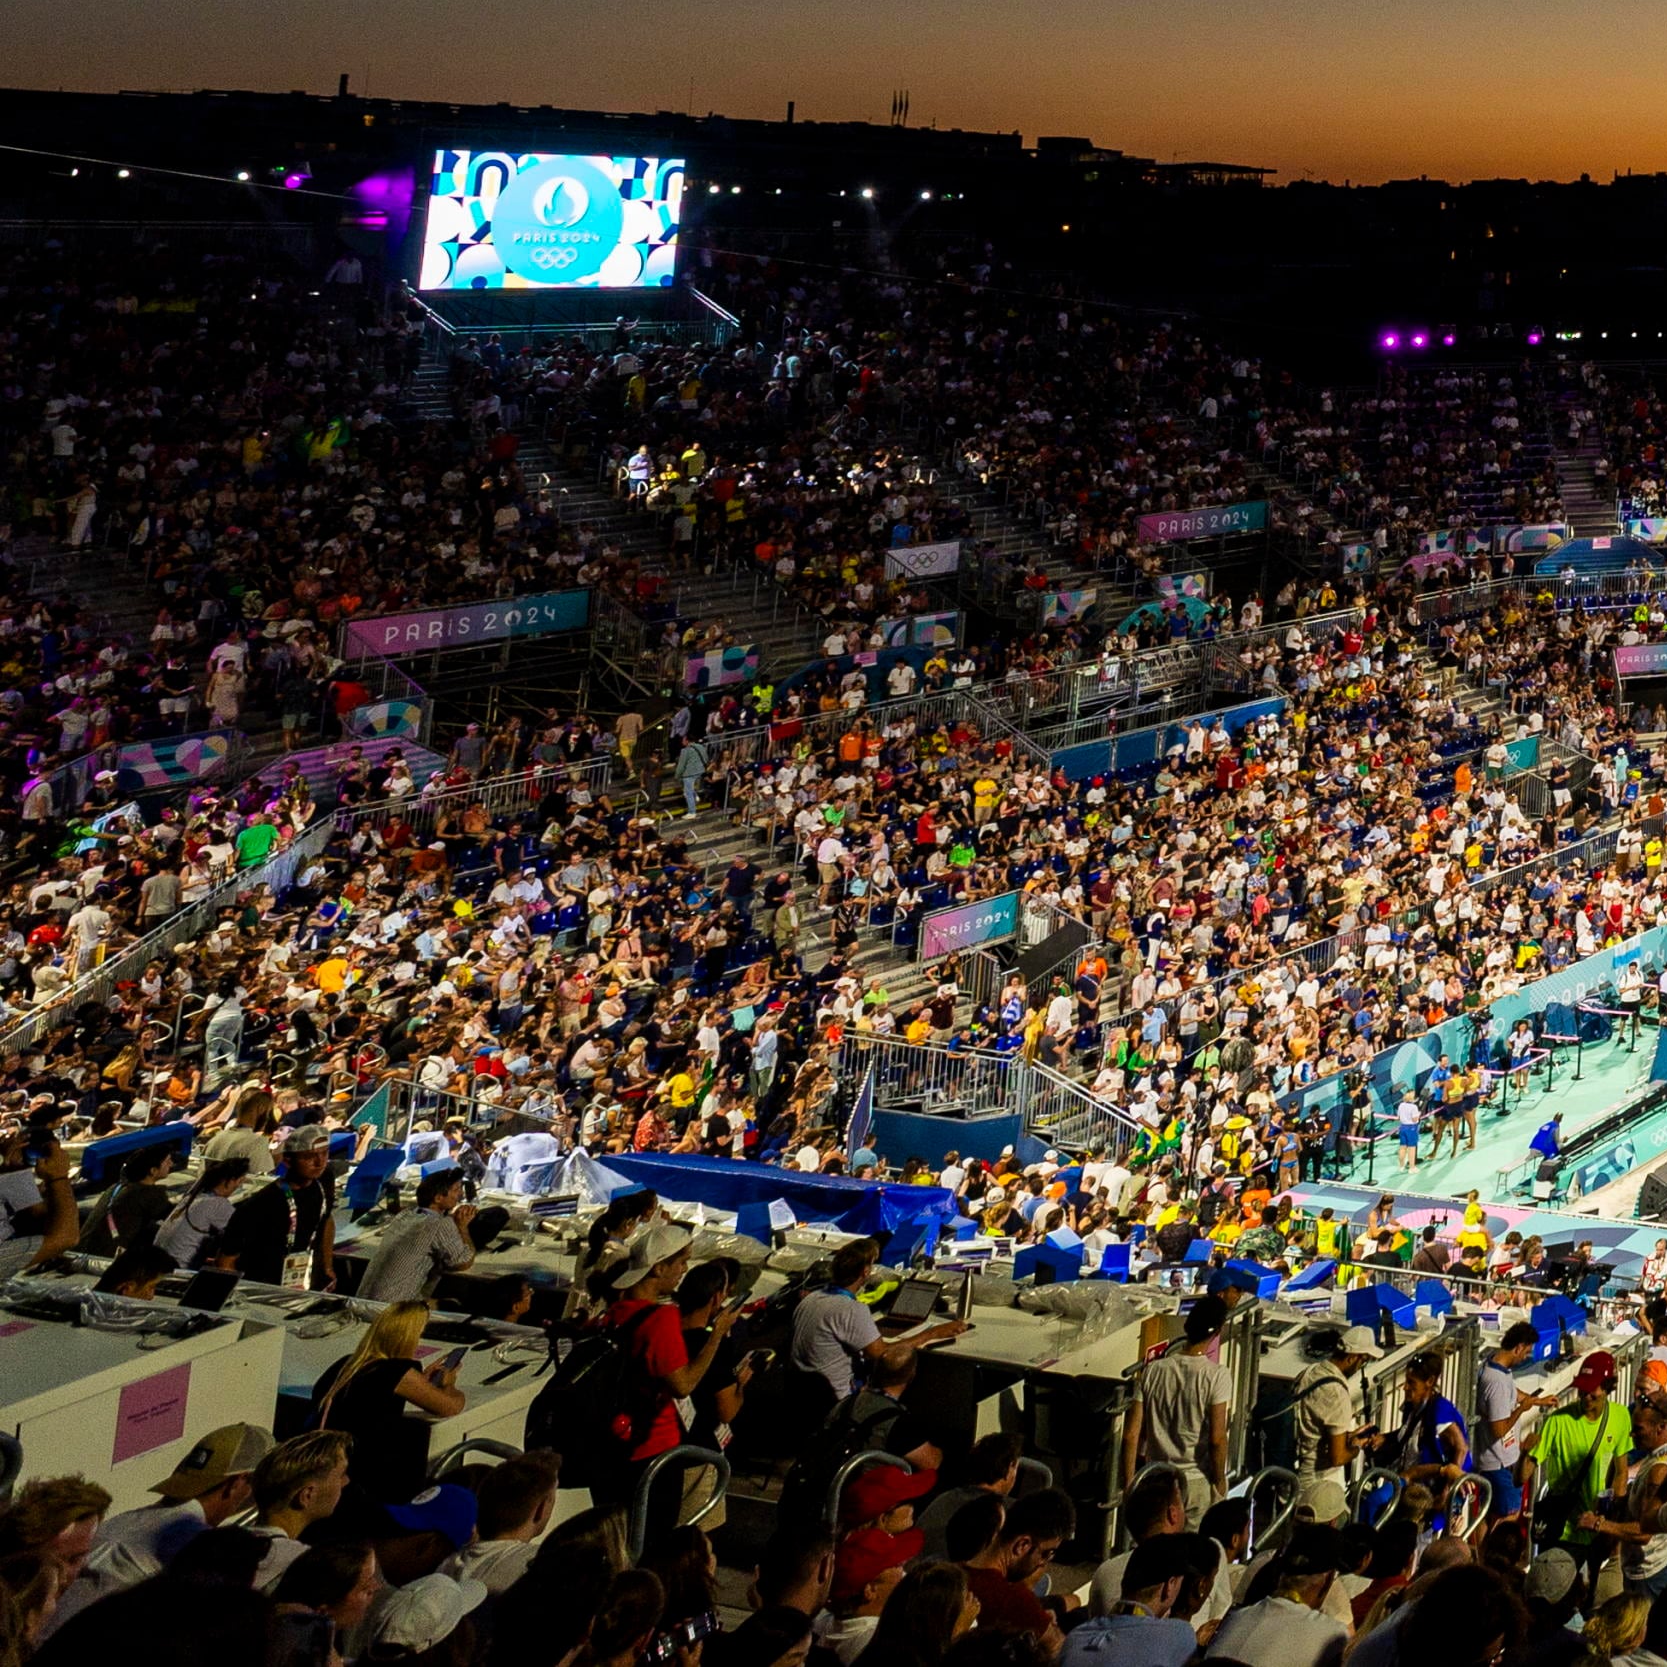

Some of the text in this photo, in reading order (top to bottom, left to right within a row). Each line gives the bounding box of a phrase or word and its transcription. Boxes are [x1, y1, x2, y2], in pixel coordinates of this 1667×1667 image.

[513, 232, 601, 244] PARIS 2024
[1158, 511, 1249, 534] PARIS 2024
[385, 606, 556, 645] PARIS 2024
[975, 911, 1010, 928] 2024
